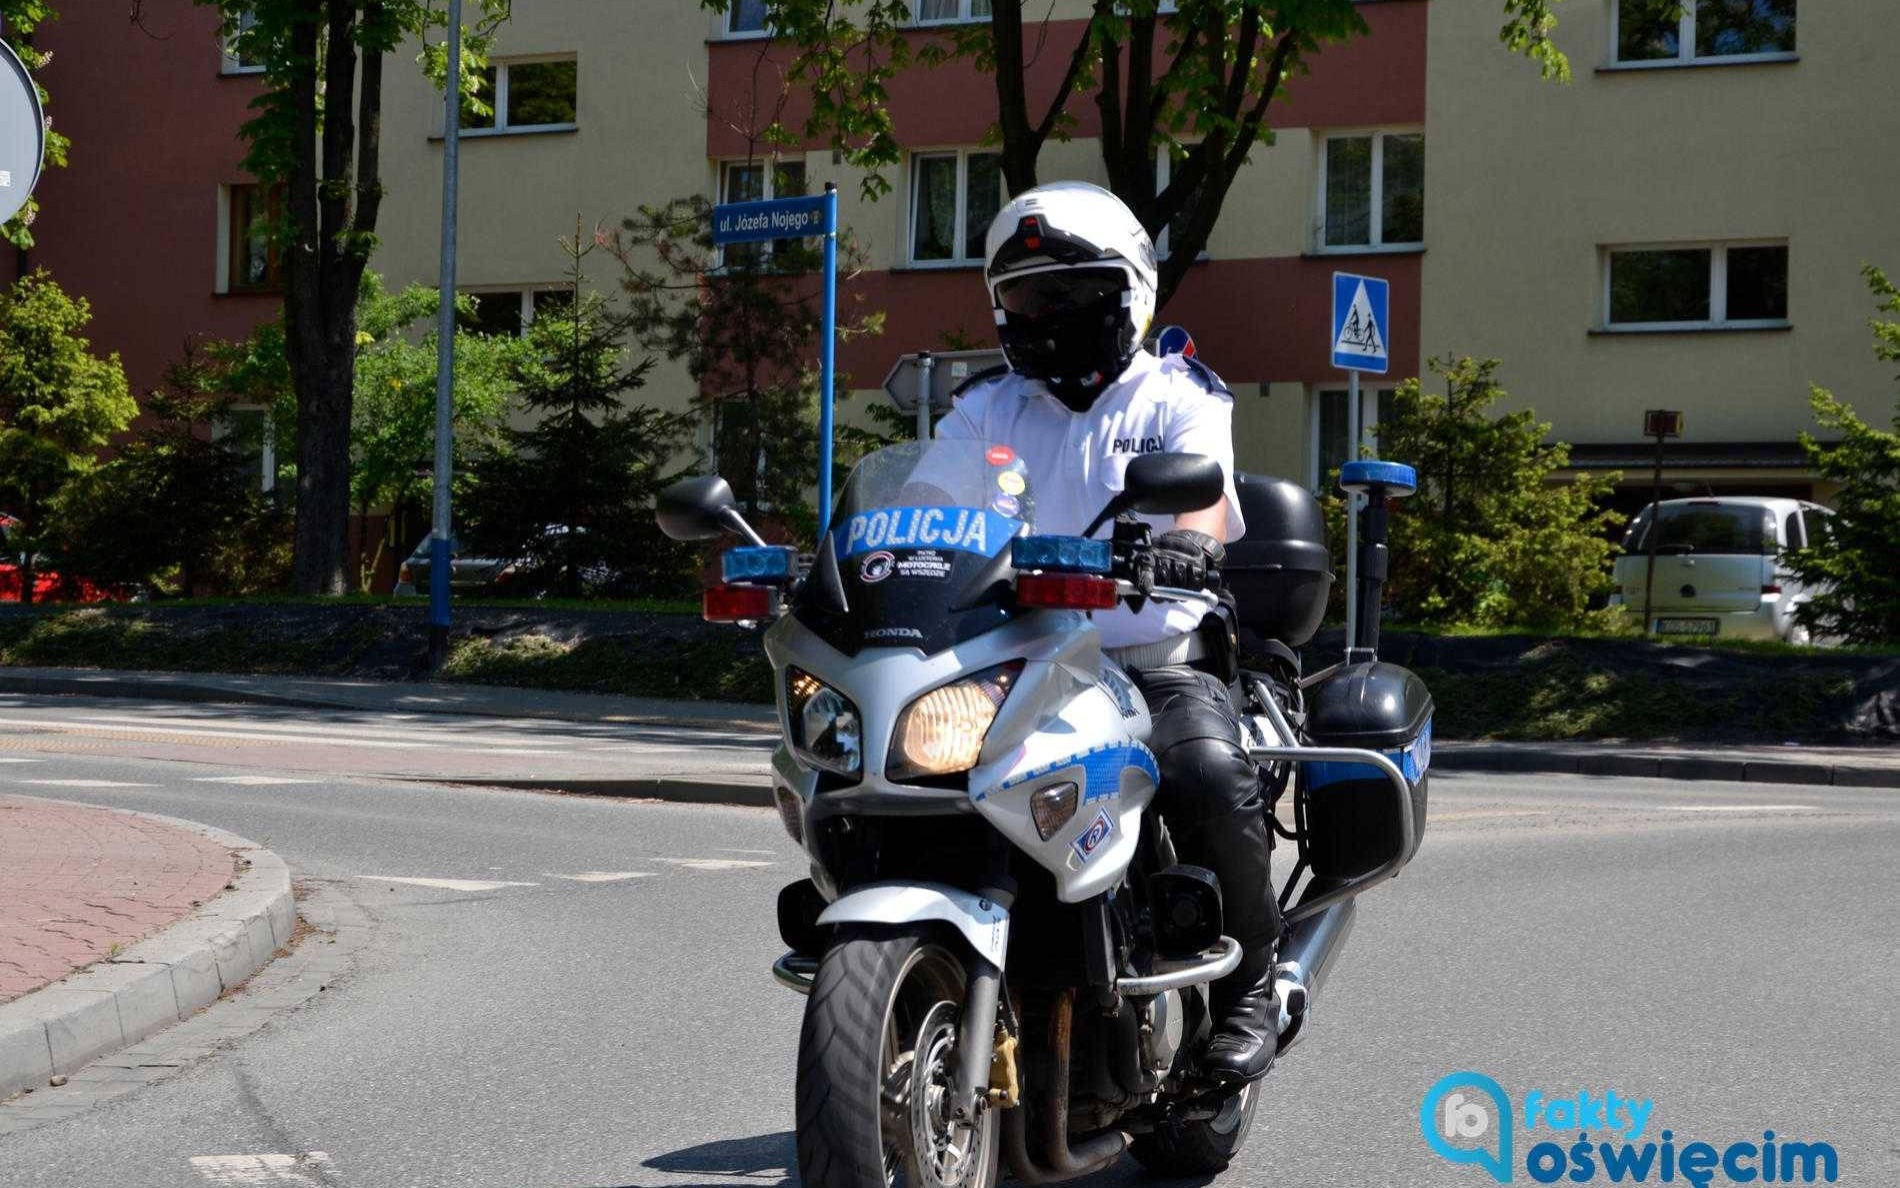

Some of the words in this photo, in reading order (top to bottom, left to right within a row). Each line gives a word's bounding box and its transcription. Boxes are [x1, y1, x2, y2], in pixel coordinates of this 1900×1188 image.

[720, 216, 732, 232] ul.
[735, 213, 769, 231] Józefa
[771, 210, 809, 231] Nojego
[1112, 435, 1165, 453] POLICJ
[846, 508, 986, 554] POLICJA
[864, 628, 923, 639] HONDA
